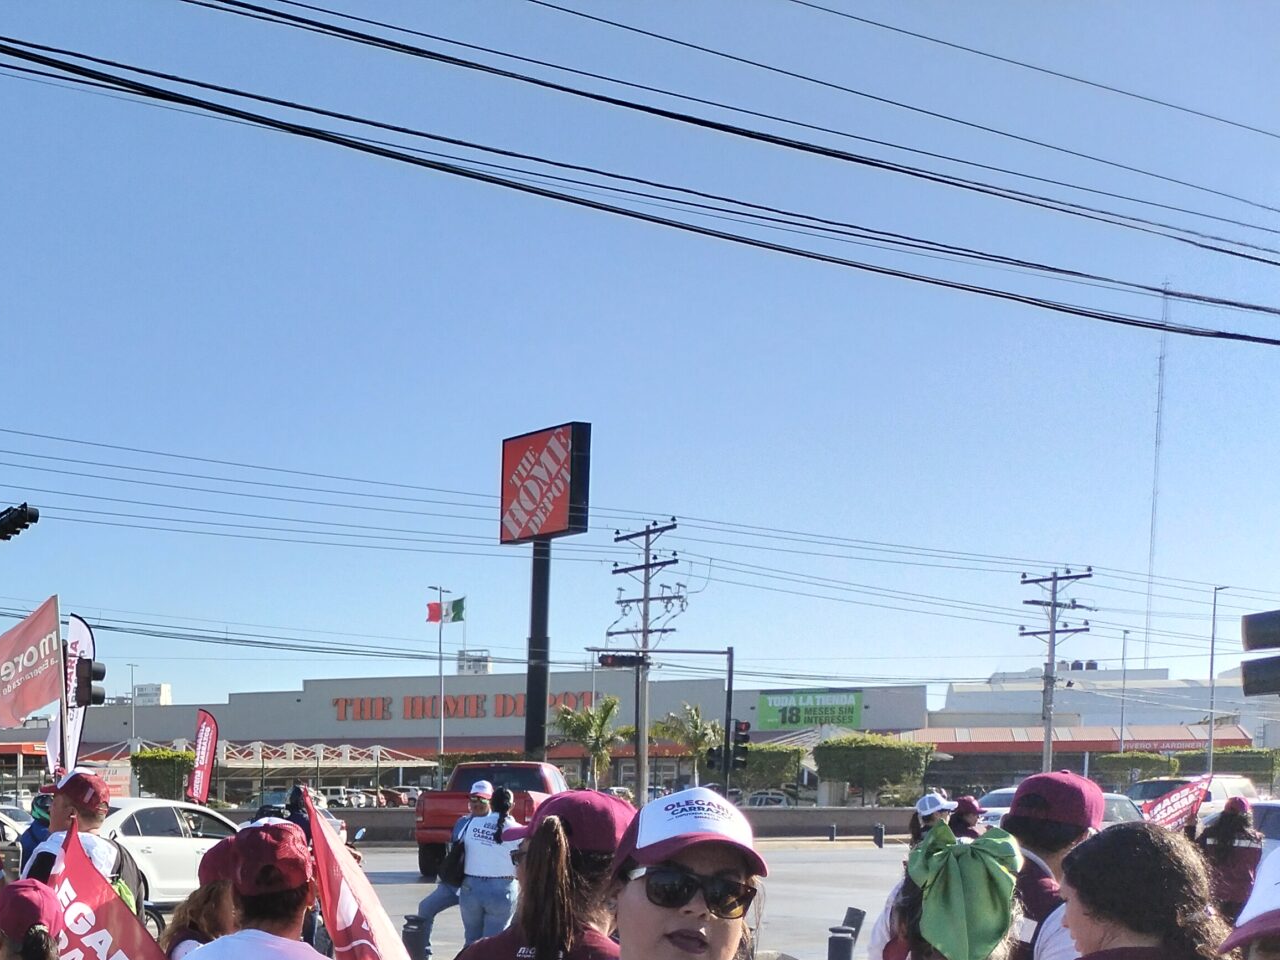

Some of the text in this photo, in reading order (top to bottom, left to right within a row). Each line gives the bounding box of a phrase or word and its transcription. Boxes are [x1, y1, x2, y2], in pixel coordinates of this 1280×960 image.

[509, 445, 539, 488] THE
[502, 428, 571, 539] HOME
[528, 463, 571, 535] DEPOT
[332, 695, 392, 721] THE
[403, 693, 487, 720] HOME
[767, 694, 856, 706] TODA LA TIENDA
[778, 706, 800, 724] 18
[804, 706, 835, 715] MESES
[838, 706, 854, 715] SIN
[804, 714, 854, 724] INTERESES
